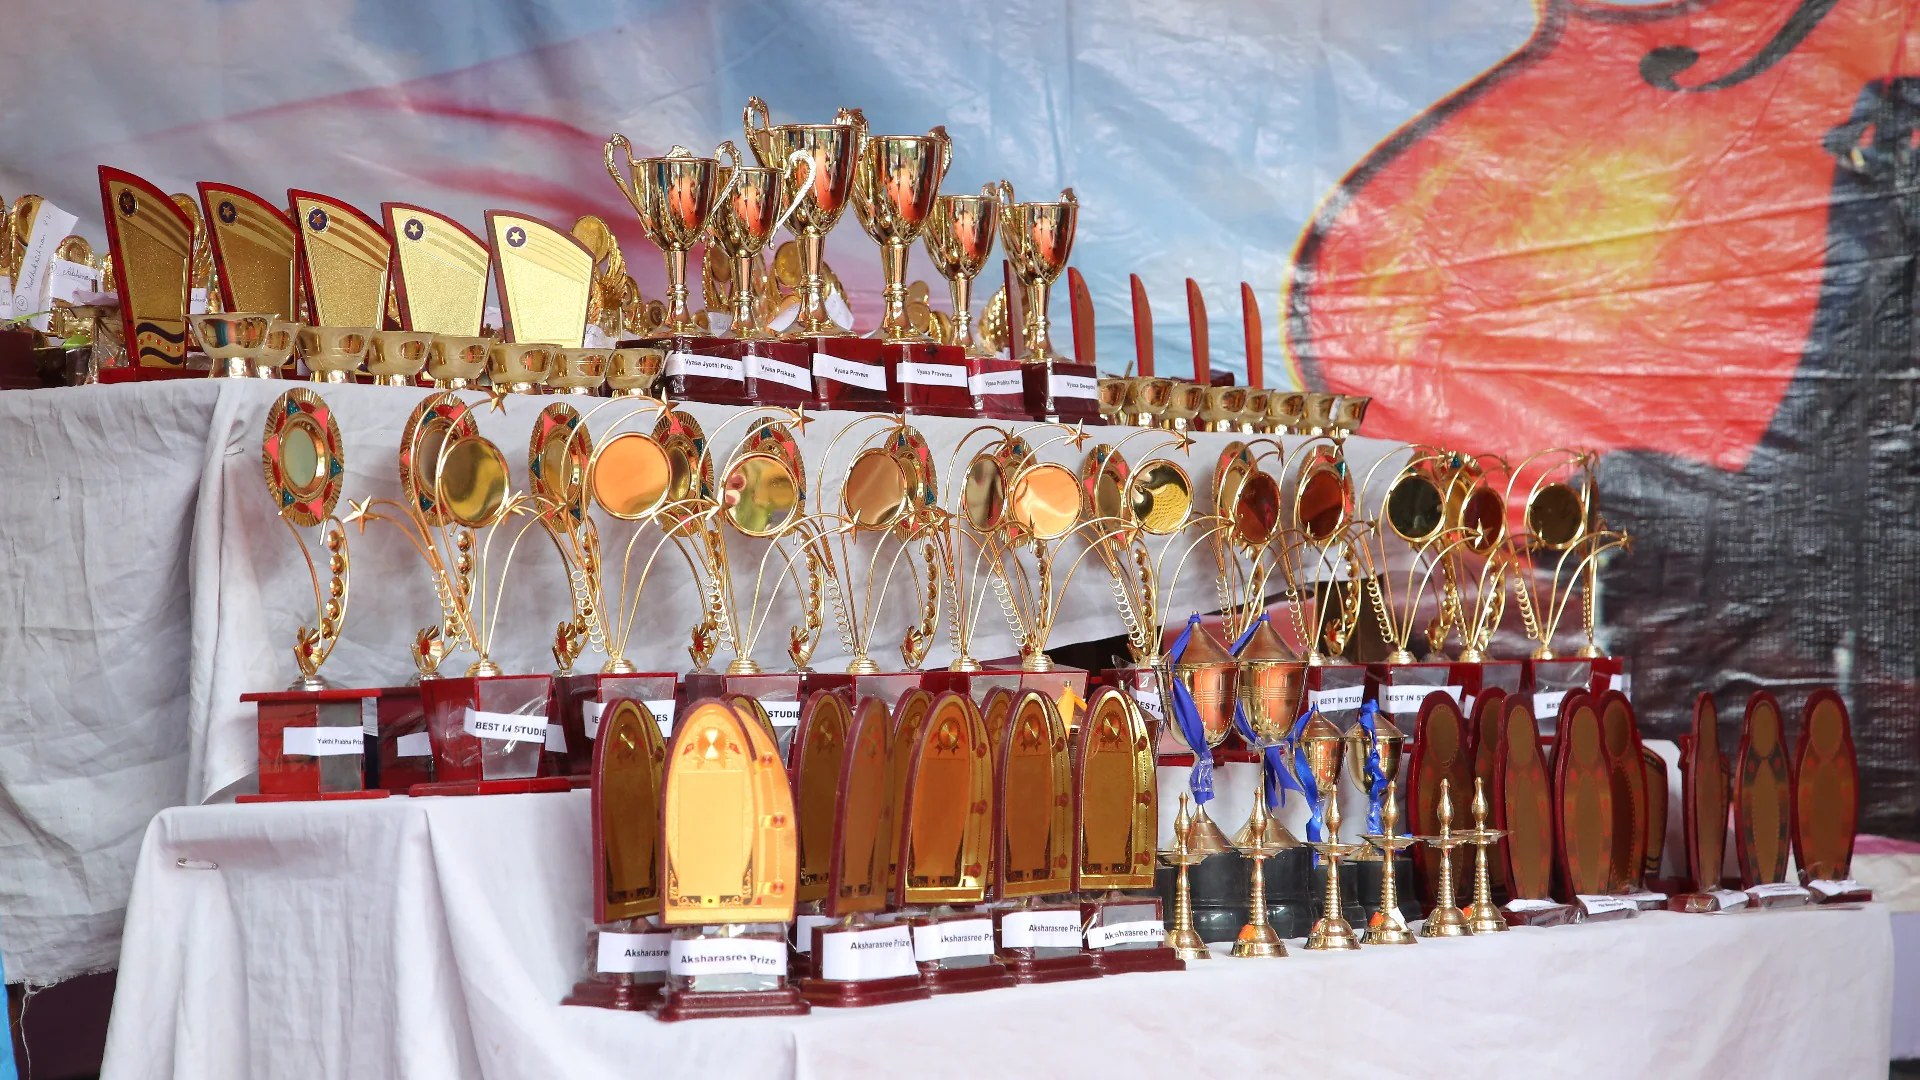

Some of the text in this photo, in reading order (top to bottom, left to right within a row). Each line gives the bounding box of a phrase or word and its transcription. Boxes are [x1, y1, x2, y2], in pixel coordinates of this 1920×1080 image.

[1136, 699, 1156, 711] EST
[1320, 697, 1335, 705] BEST
[475, 721, 499, 731] BEST
[502, 724, 511, 733] IN
[1028, 924, 1068, 933] Aksharasree
[850, 938, 910, 950] Aksharasree Prize
[624, 948, 671, 957] Aksharasre
[750, 954, 777, 966] Prize
